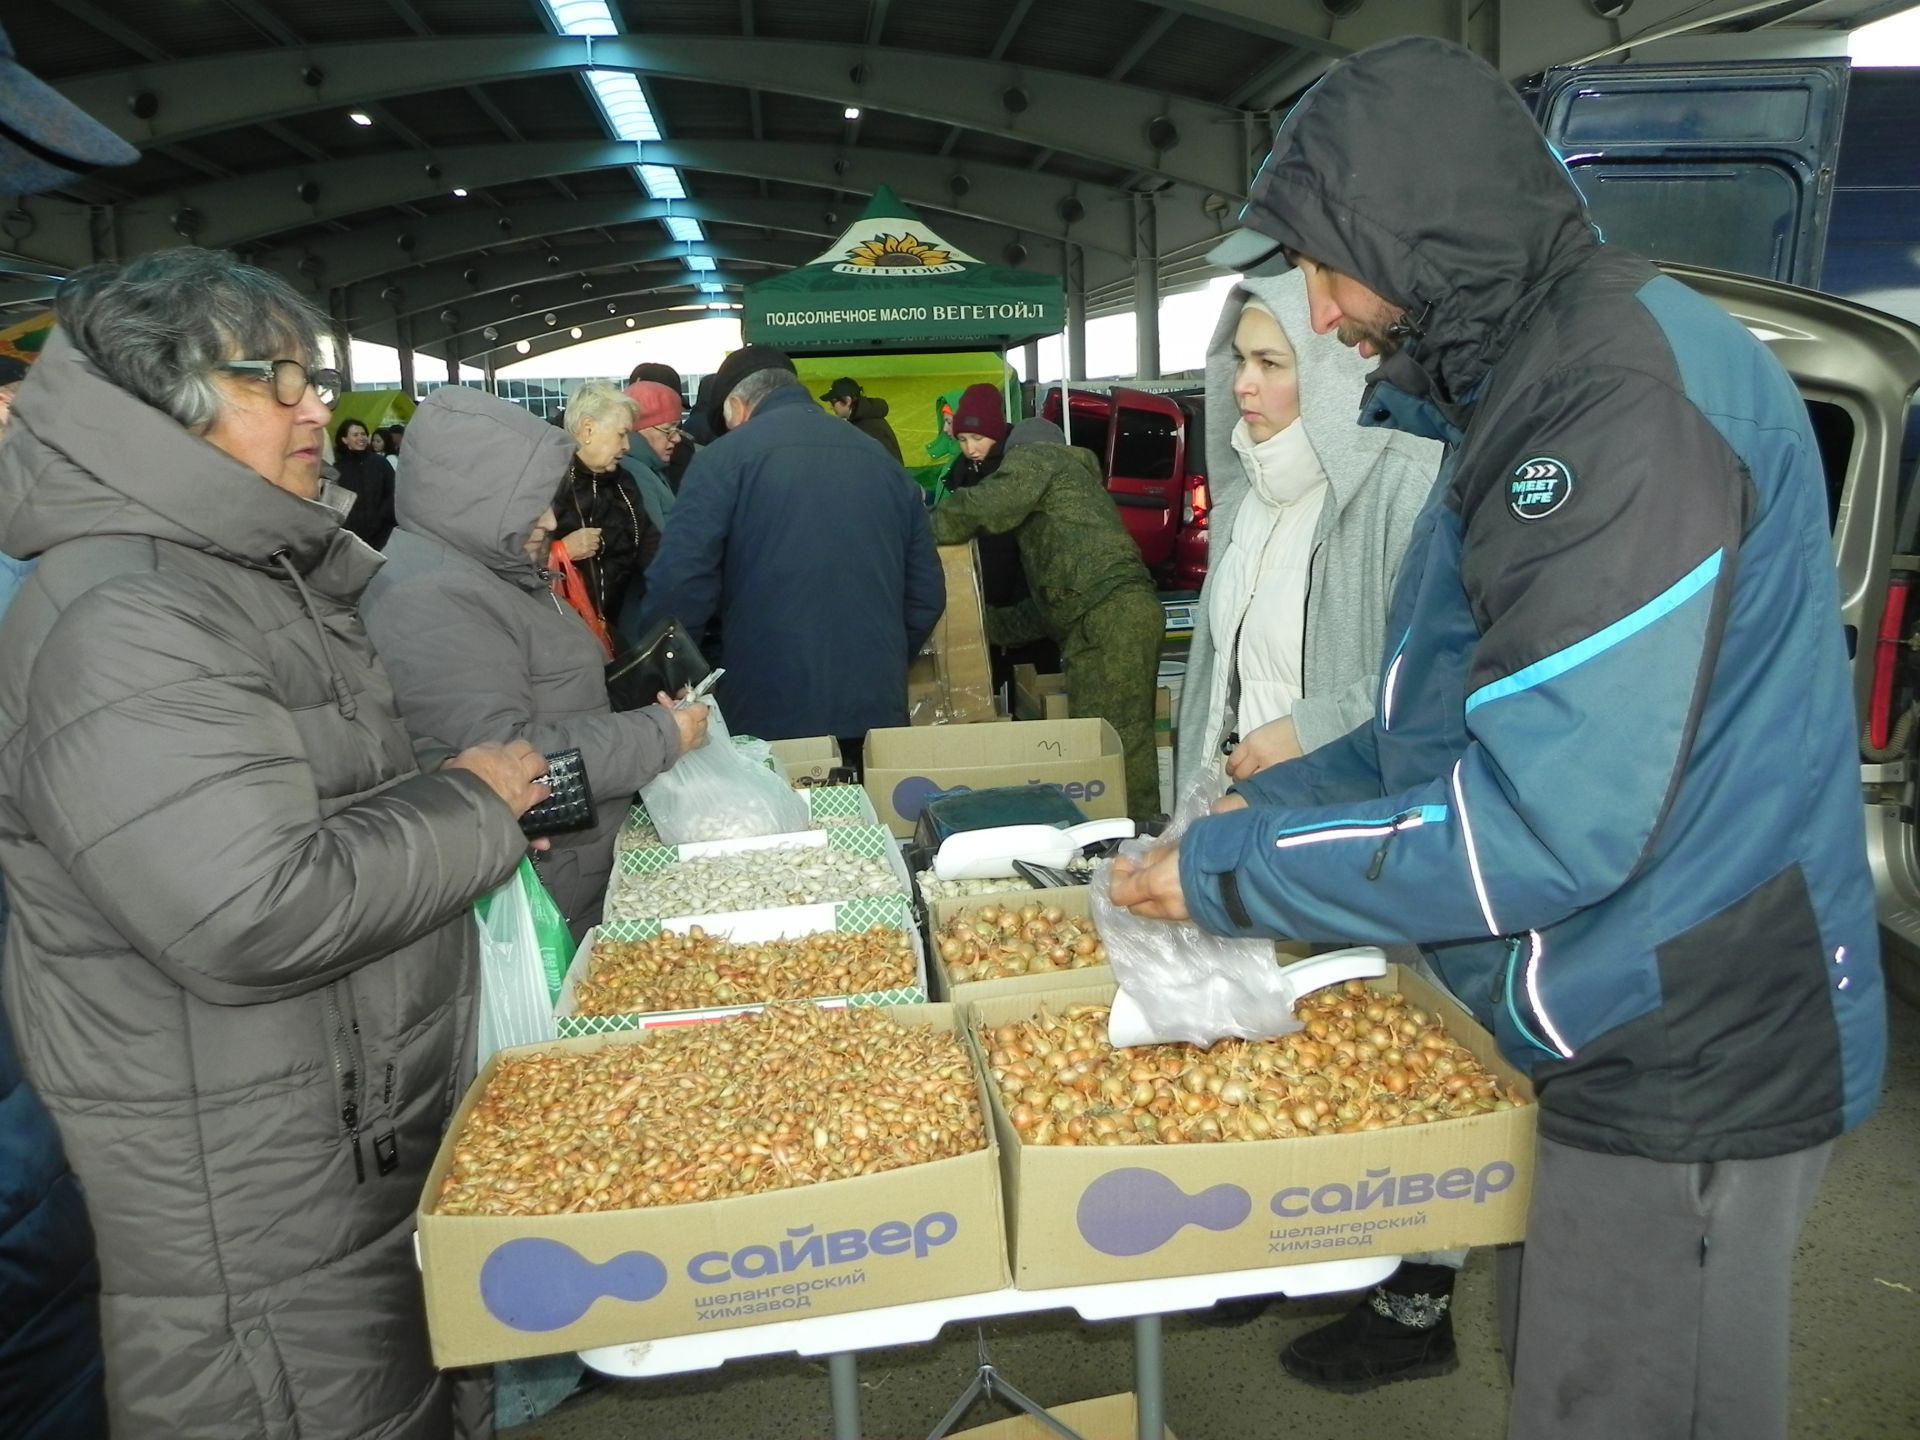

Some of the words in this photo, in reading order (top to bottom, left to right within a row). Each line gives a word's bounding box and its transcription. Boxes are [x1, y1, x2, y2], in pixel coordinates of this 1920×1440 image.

[766, 309, 878, 326] ПОДСОЛНЕЧНОЕ
[880, 307, 927, 321] МАСЛО
[933, 301, 1044, 321] ВЕГЕТОЙЛ
[1511, 479, 1558, 494] MEET
[1517, 491, 1553, 505] LIFE
[1270, 1160, 1515, 1218] сайвер
[1270, 1211, 1427, 1240] шелангерский
[687, 1211, 958, 1285] сайвер
[1268, 1234, 1373, 1254] химзавод
[694, 1268, 866, 1308] шелангерский
[697, 1295, 811, 1321] химзавод
